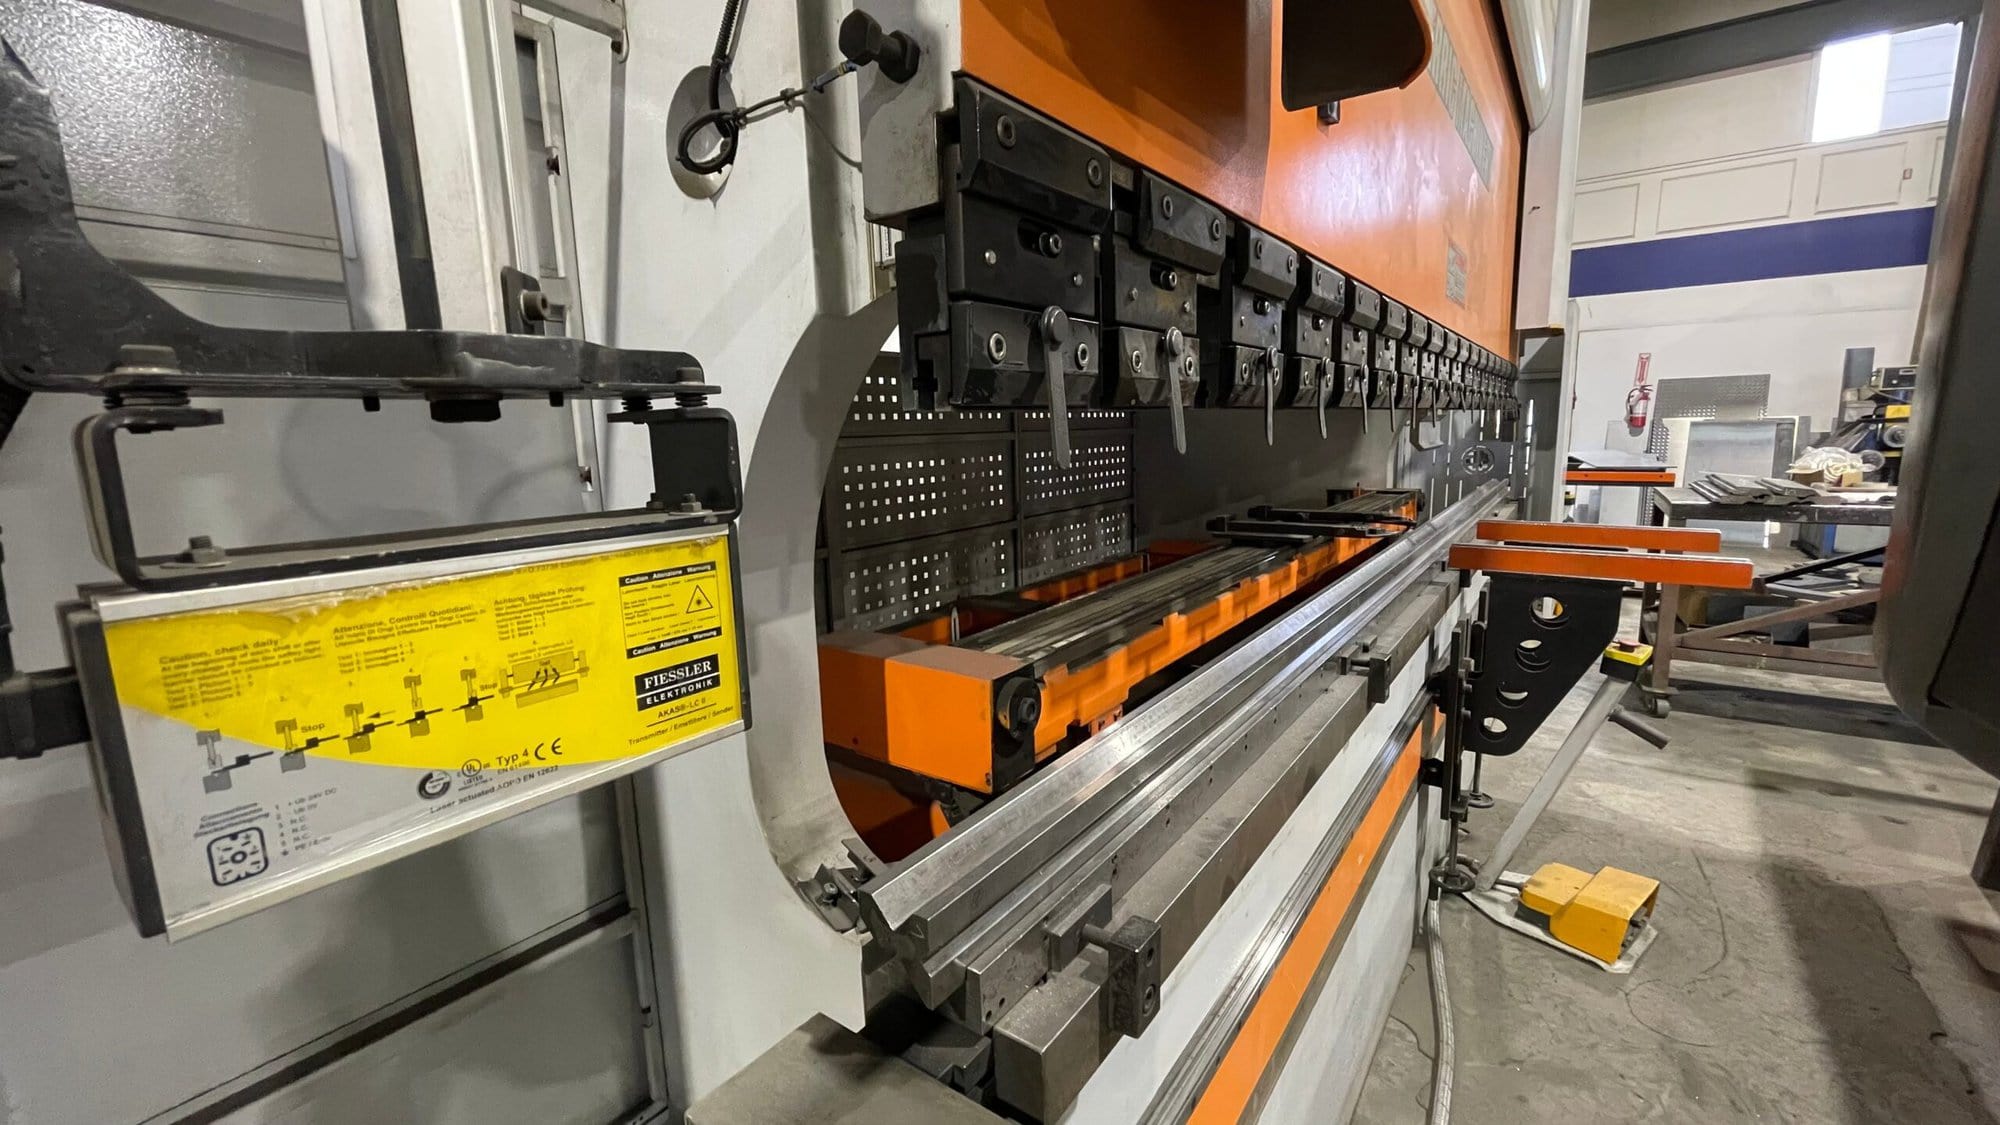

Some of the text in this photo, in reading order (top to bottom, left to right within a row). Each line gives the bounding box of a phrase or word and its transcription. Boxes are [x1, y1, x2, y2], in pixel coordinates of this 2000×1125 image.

[624, 575, 648, 584] Caution
[686, 564, 711, 573] Warnung
[252, 638, 279, 650] daily
[632, 644, 656, 656] Caution
[644, 660, 712, 690] FIESSLER
[646, 678, 713, 705] ELEKTRONIK
[300, 722, 326, 734] Stop
[628, 728, 668, 745] Transmitter
[712, 705, 734, 718] Sender
[496, 753, 518, 766] Typ
[522, 748, 528, 758] 4
[522, 773, 535, 784] EN
